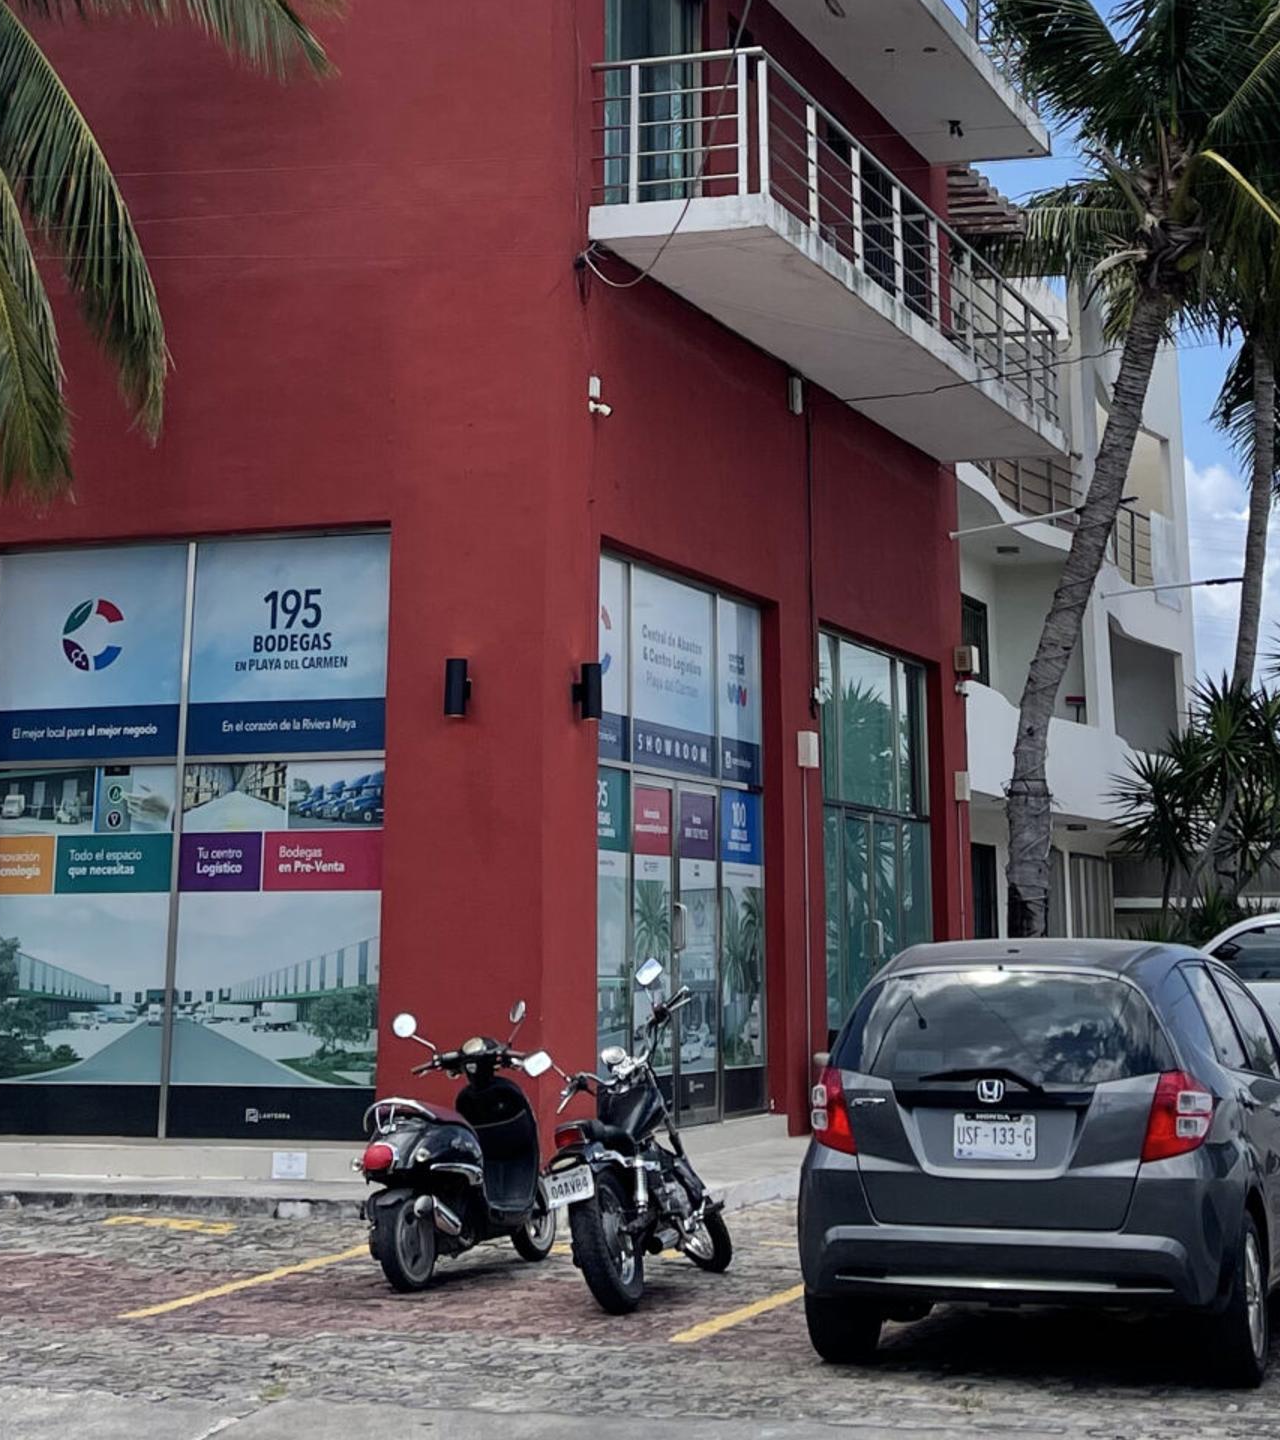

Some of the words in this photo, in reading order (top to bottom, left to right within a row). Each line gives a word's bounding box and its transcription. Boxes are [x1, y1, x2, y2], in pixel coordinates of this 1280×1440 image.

[264, 588, 322, 630] 195
[253, 632, 332, 653] BODEGAS
[235, 661, 247, 672] EN
[248, 658, 281, 671] PLAYA
[284, 659, 300, 670] DEL
[301, 656, 348, 669] CARMEN
[12, 728, 20, 739] El
[21, 727, 45, 741] mejor
[46, 726, 66, 738] local
[67, 728, 85, 740] para
[87, 725, 95, 736] el
[97, 725, 122, 739] mejor
[123, 724, 157, 738] negocio
[222, 720, 233, 732] En
[235, 720, 243, 732] el
[279, 718, 291, 730] de
[292, 718, 300, 730] la
[302, 718, 331, 730] Riviera
[332, 717, 356, 732] Maya
[638, 733, 707, 763] SHOWROOM
[69, 849, 93, 861] Todo
[95, 849, 104, 861] el
[106, 849, 142, 864] espacio
[197, 847, 208, 859] Tu
[210, 847, 242, 859] centro
[279, 845, 323, 861] Bodegas
[68, 866, 87, 879] que
[89, 864, 135, 876] necesitas
[278, 863, 291, 873] en
[294, 861, 345, 873] Pre-Venta
[957, 1126, 1032, 1146] USF-133-G
